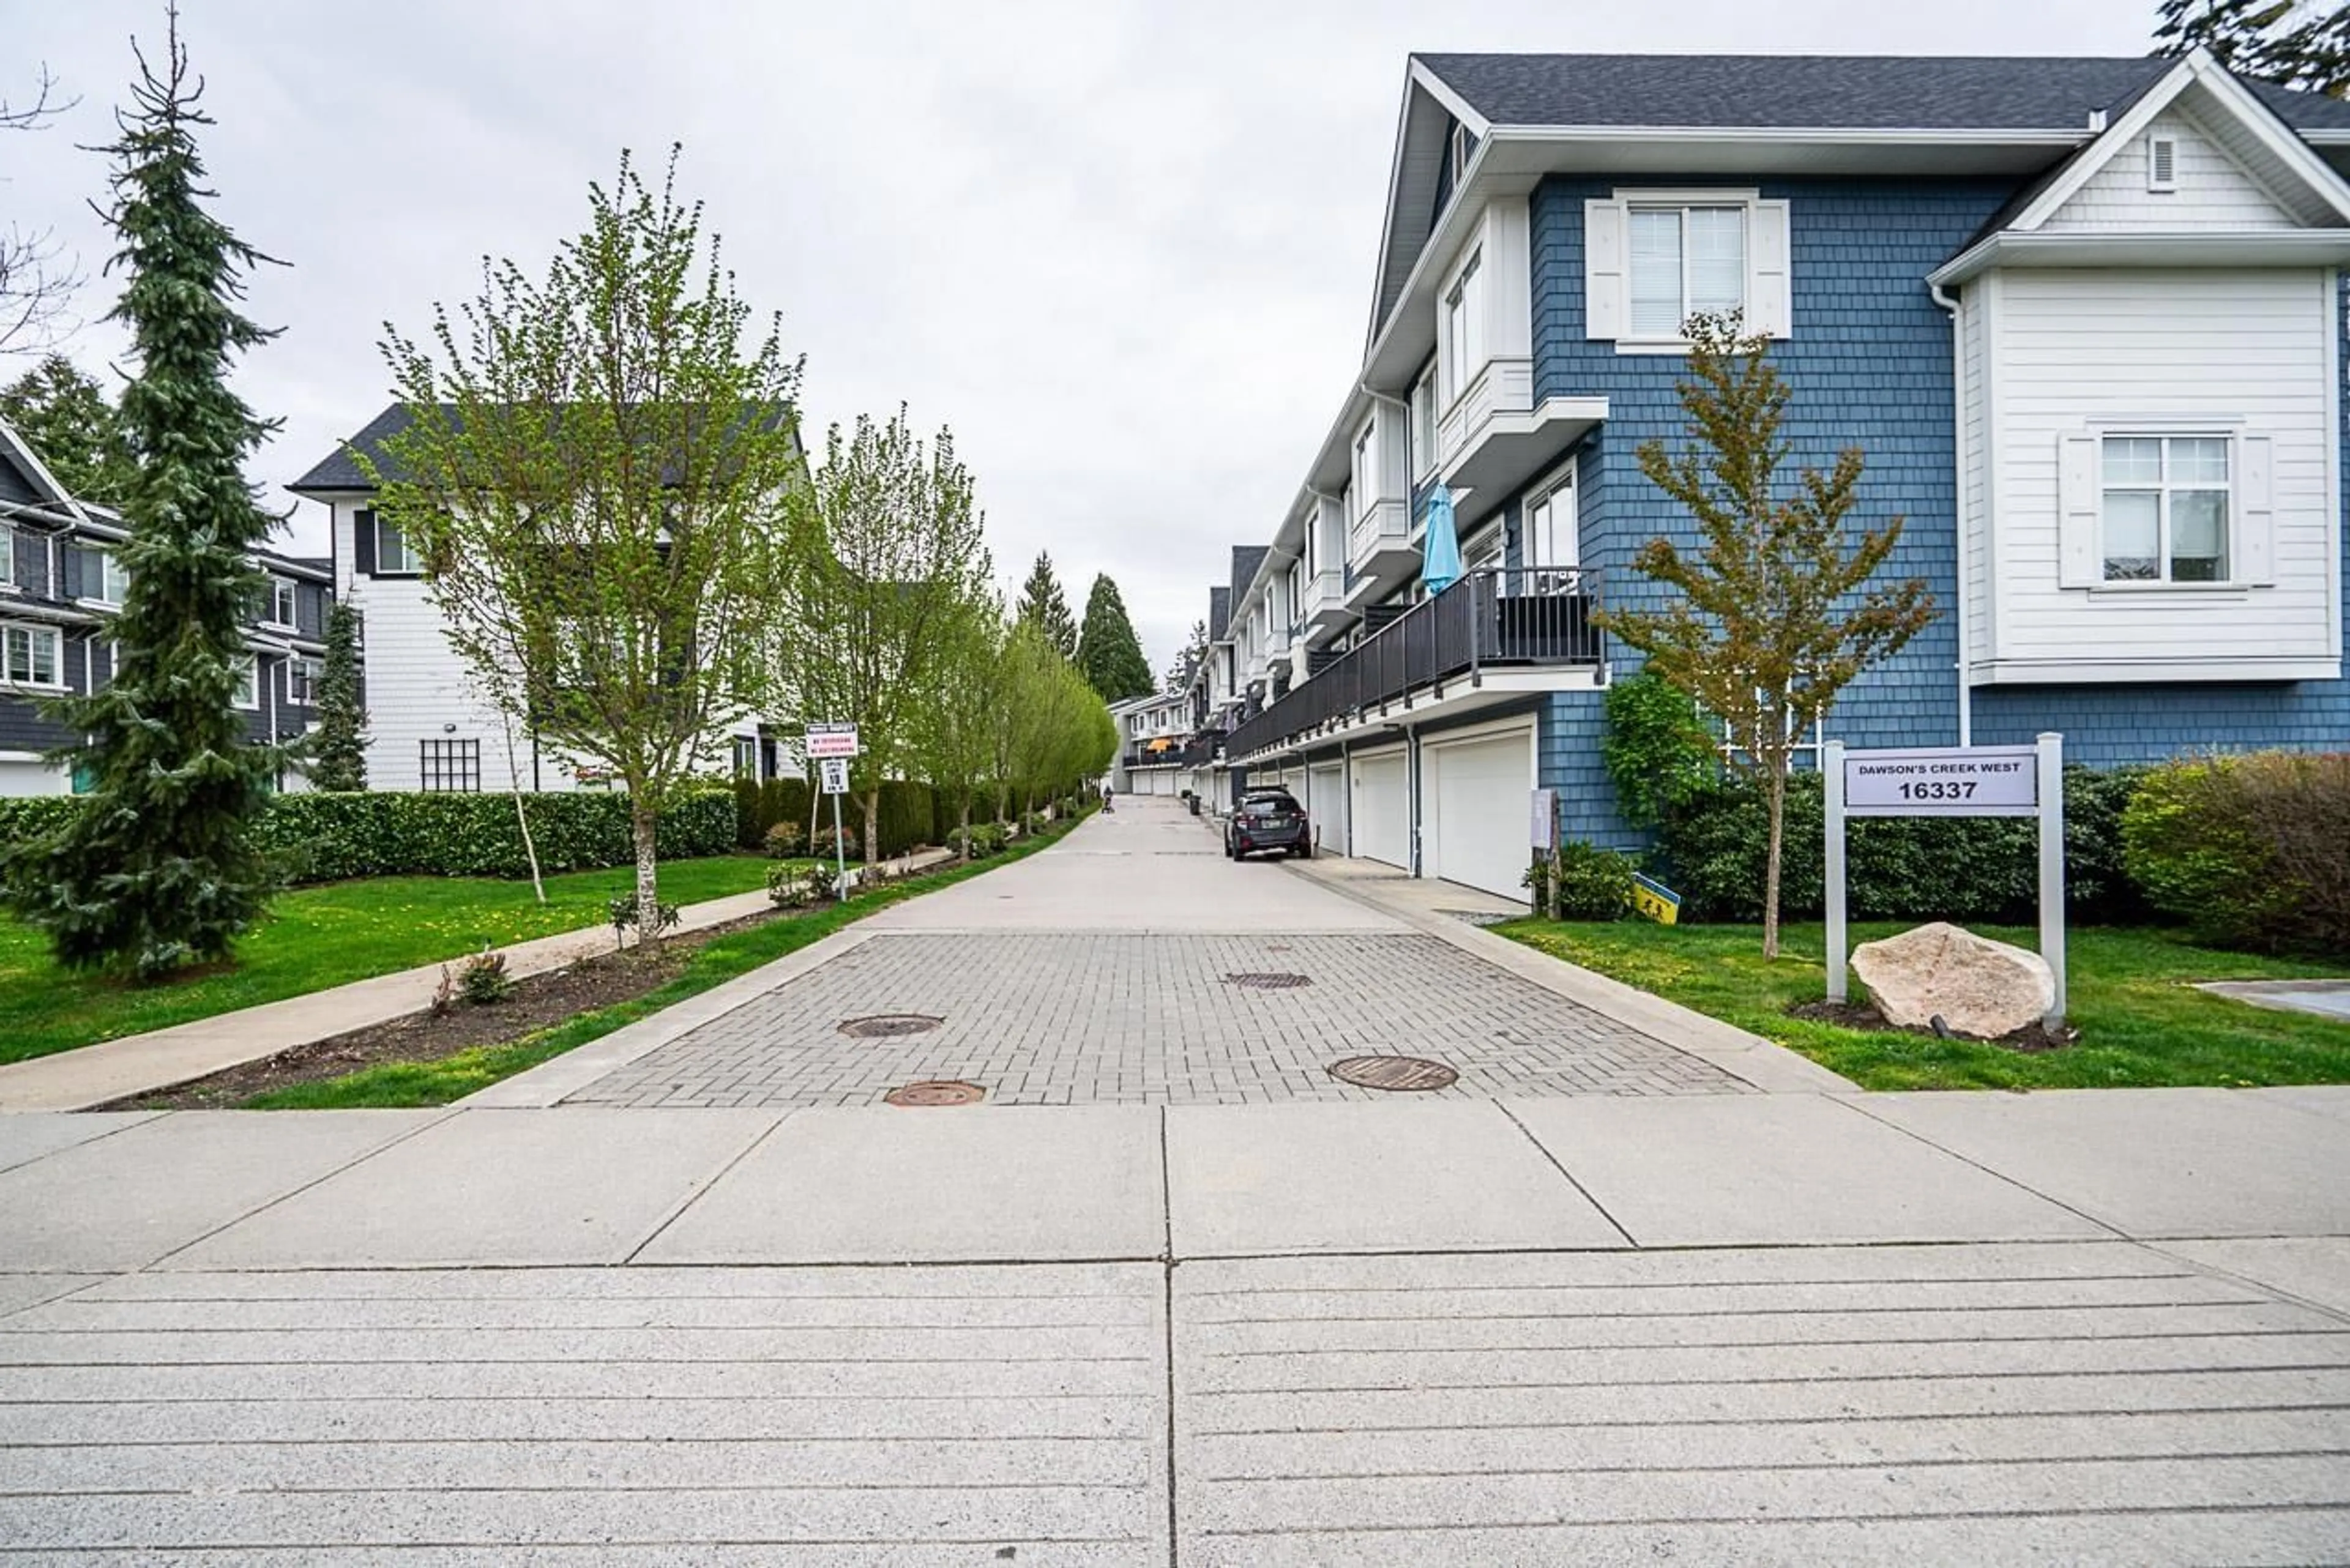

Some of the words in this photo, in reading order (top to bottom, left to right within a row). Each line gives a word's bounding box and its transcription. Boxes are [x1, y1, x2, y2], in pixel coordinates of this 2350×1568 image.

[1859, 765, 1927, 774] DAWSON'S
[1930, 763, 1977, 774] CREEK
[1980, 762, 2021, 772] WEST
[1898, 782, 1979, 799] 16337
